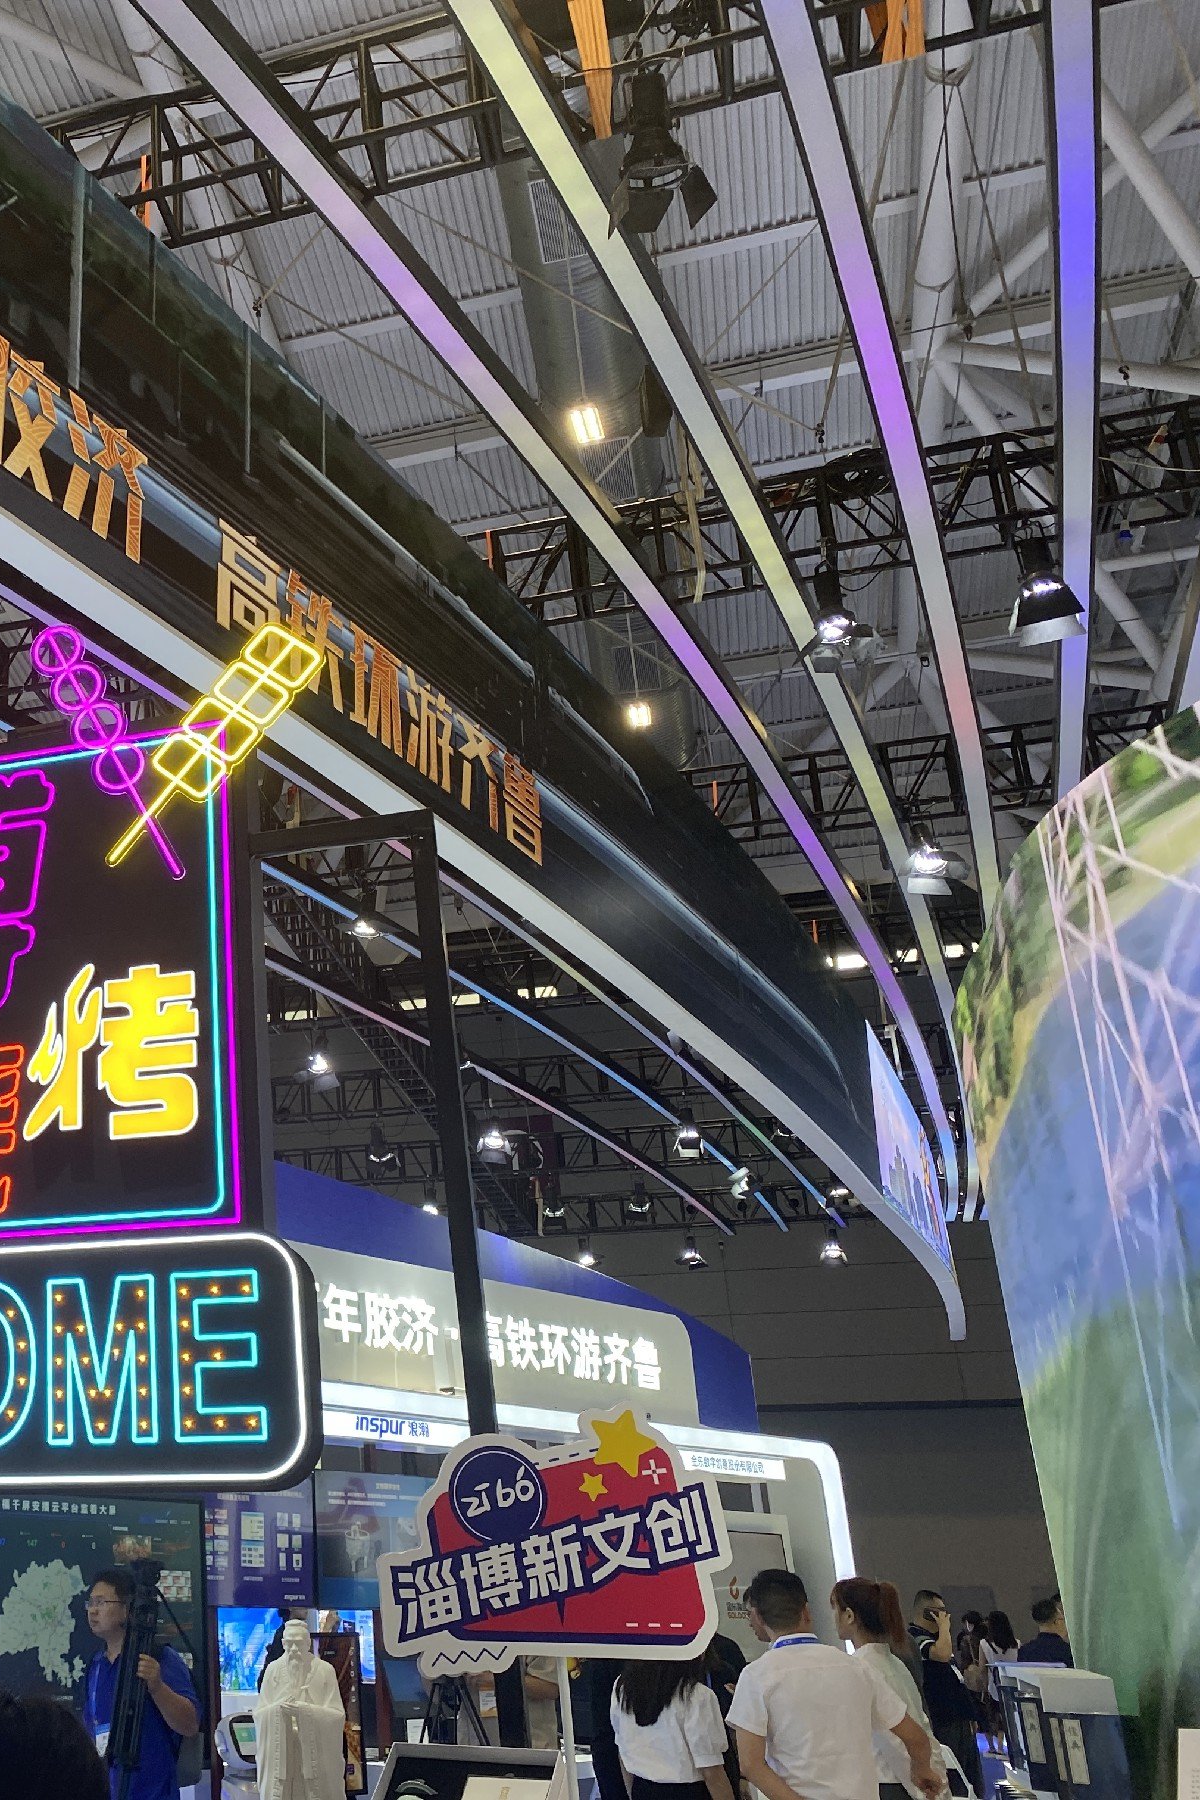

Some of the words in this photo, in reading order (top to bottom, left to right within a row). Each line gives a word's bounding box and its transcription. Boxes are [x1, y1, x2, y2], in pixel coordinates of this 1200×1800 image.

[216, 518, 543, 866] 高铁环游齐鲁
[315, 1282, 439, 1356] 年胶济
[356, 1415, 405, 1439] inspur
[397, 1488, 714, 1635] 淄博新文创
